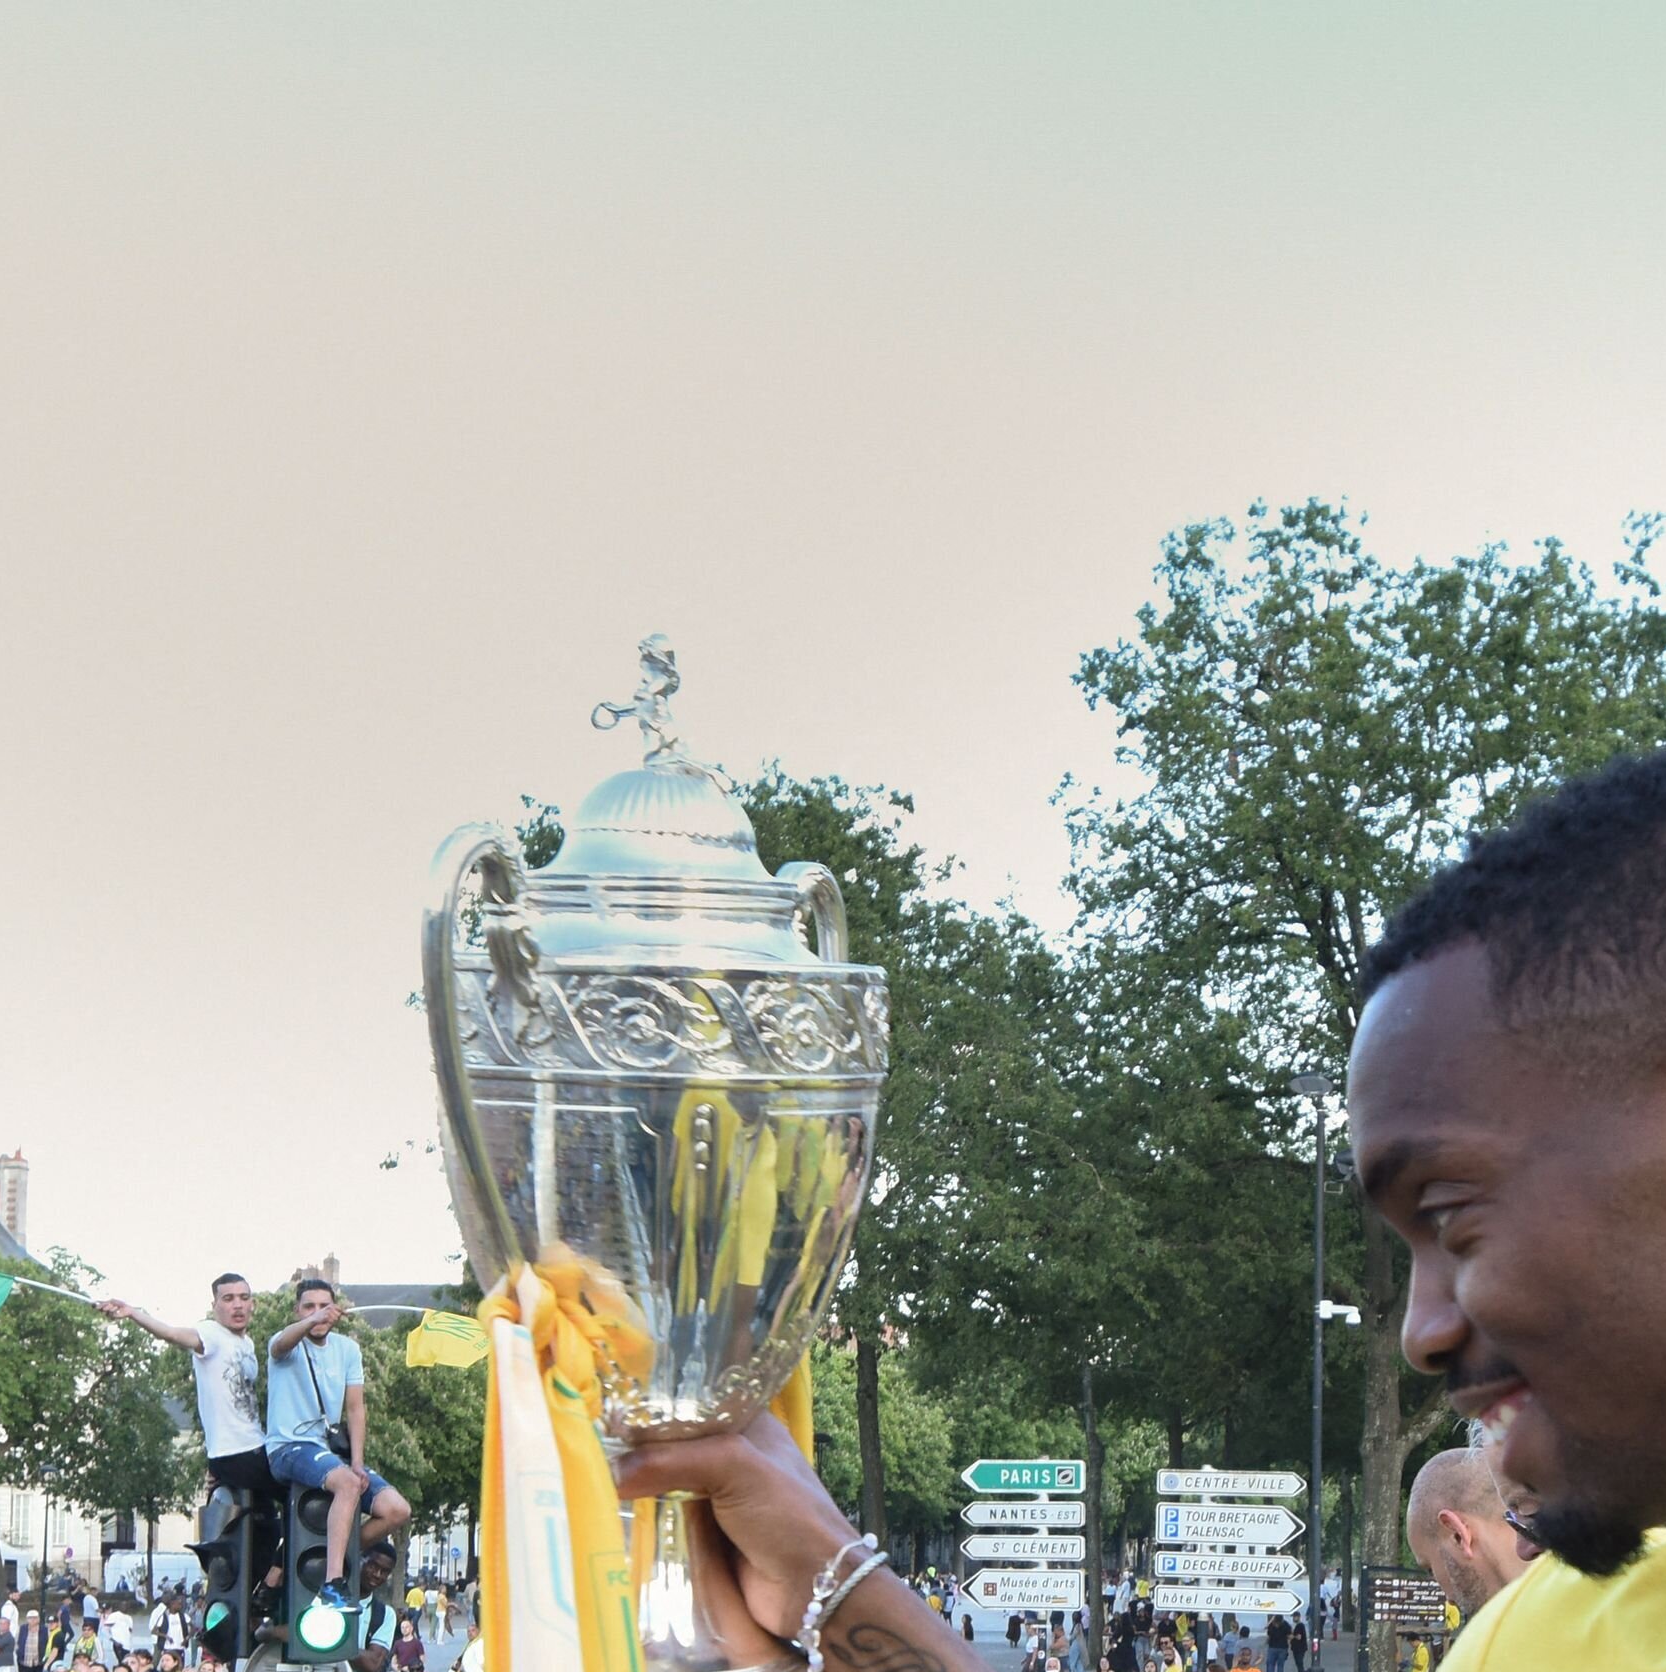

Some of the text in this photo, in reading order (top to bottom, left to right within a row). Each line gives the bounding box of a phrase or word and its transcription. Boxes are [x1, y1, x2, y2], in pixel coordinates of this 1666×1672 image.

[1000, 1469, 1051, 1484] PARIS
[1184, 1477, 1285, 1490] CENTRE-VILLE
[1185, 1511, 1217, 1523] TOUR
[1218, 1512, 1281, 1524] BRETAGNE
[1185, 1526, 1244, 1538] TALENSAC
[1013, 1540, 1078, 1554] CLÉMENT
[1182, 1558, 1290, 1574] DECRÉ-BOUFFAY
[1000, 1577, 1075, 1588] Musée d'arts
[1000, 1592, 1013, 1602] de
[1162, 1592, 1198, 1604] hôtel
[1206, 1594, 1221, 1605] de
